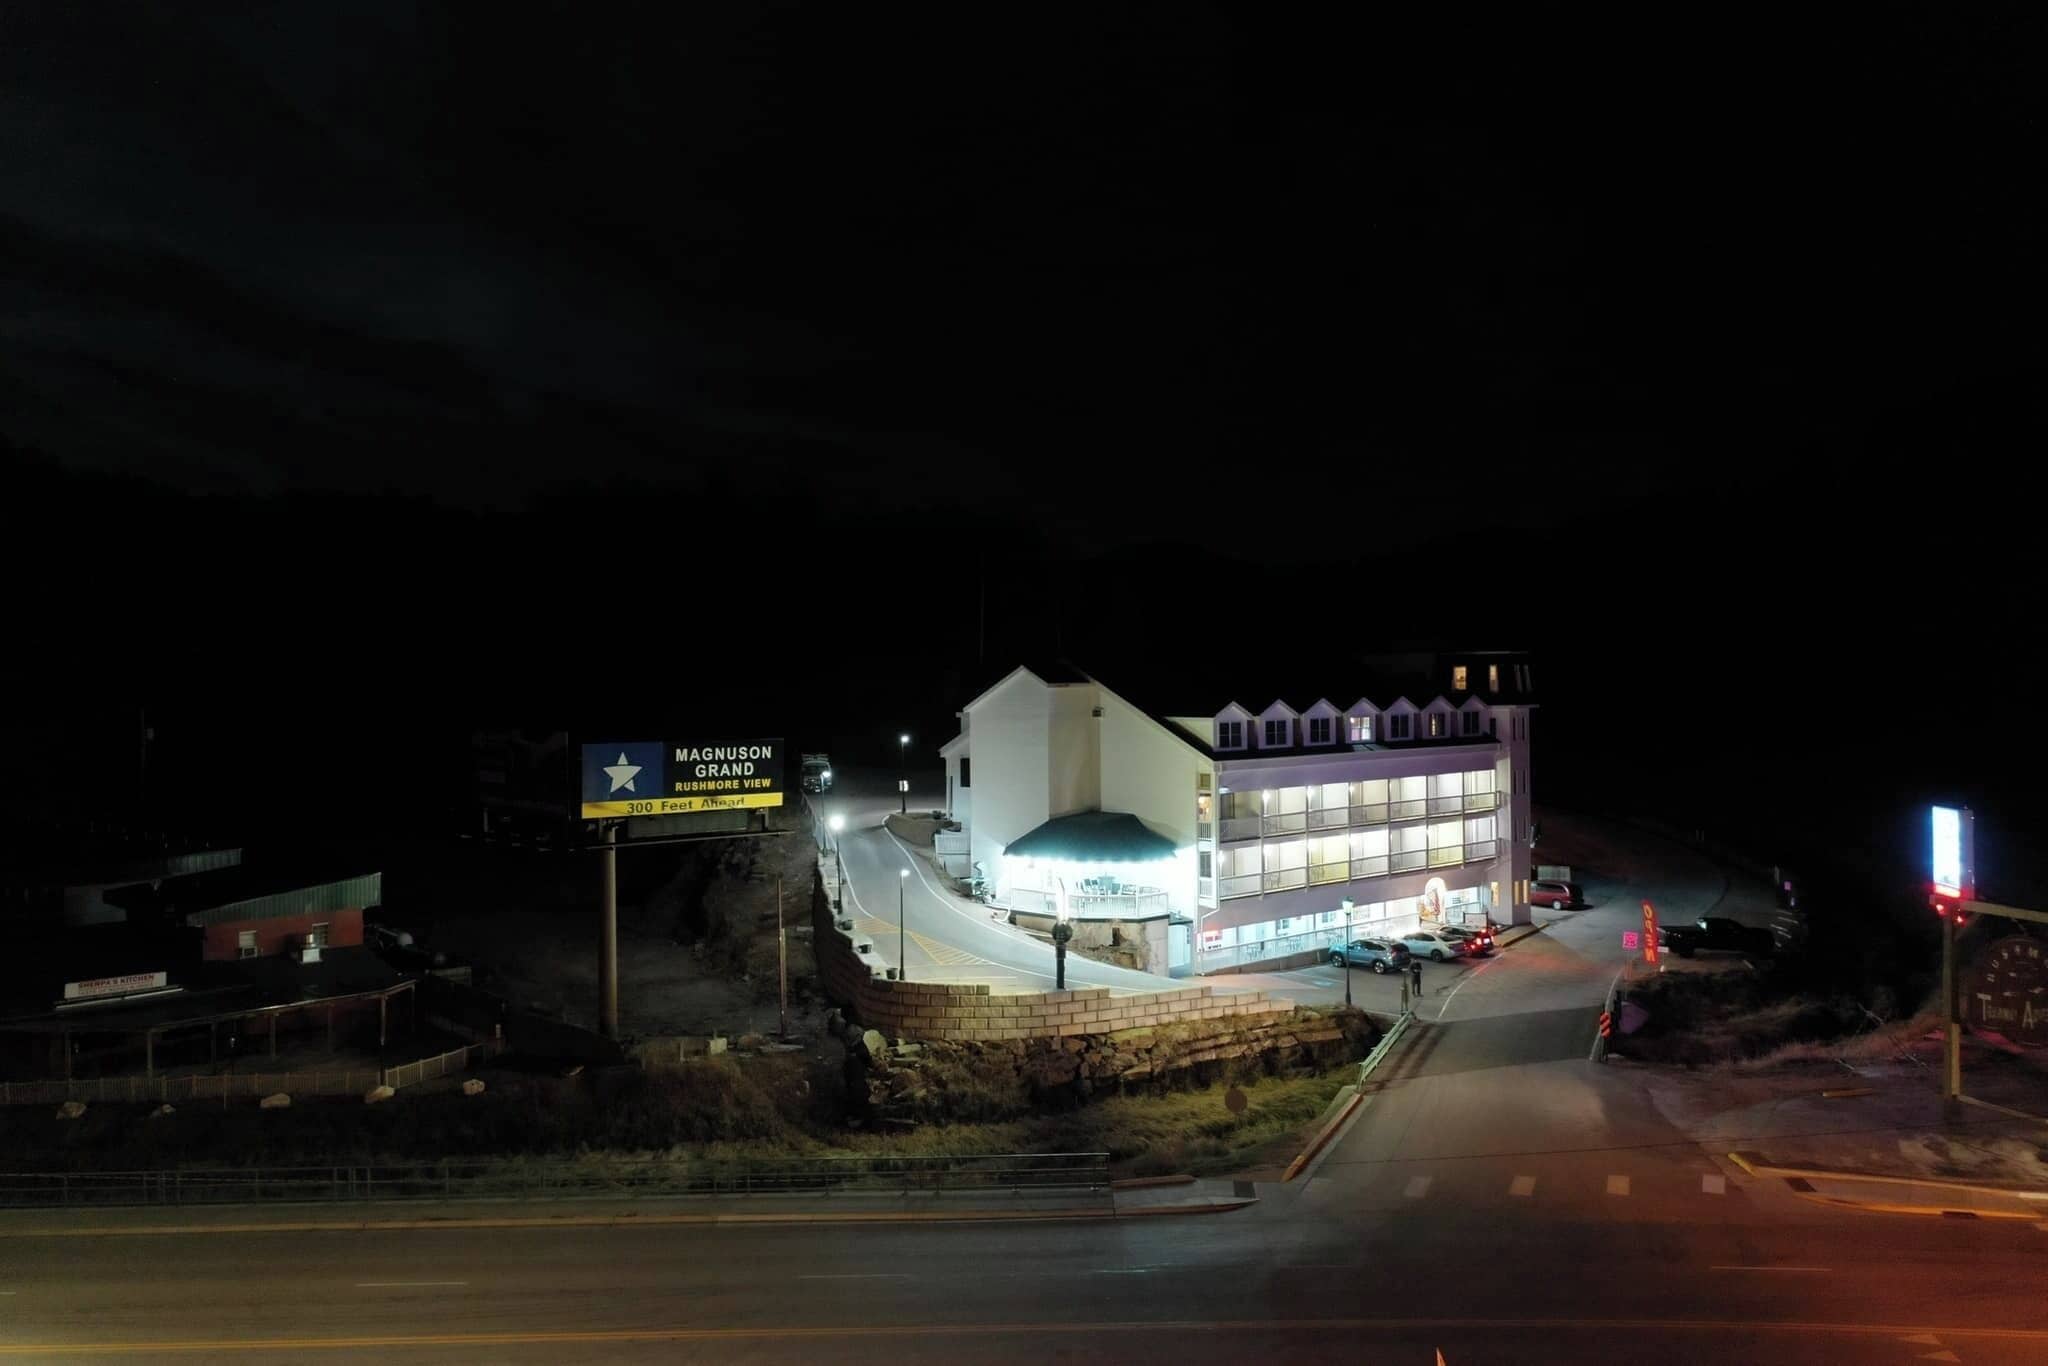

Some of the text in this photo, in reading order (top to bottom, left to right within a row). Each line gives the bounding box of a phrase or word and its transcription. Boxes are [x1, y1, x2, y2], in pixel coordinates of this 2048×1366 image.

[675, 746, 772, 762] MAGNUSON
[695, 762, 754, 778] GRAND
[675, 777, 772, 792] RUSHMORE VIEW
[627, 797, 745, 814] 300 Feet Ahead
[120, 975, 154, 984] KITCHEN
